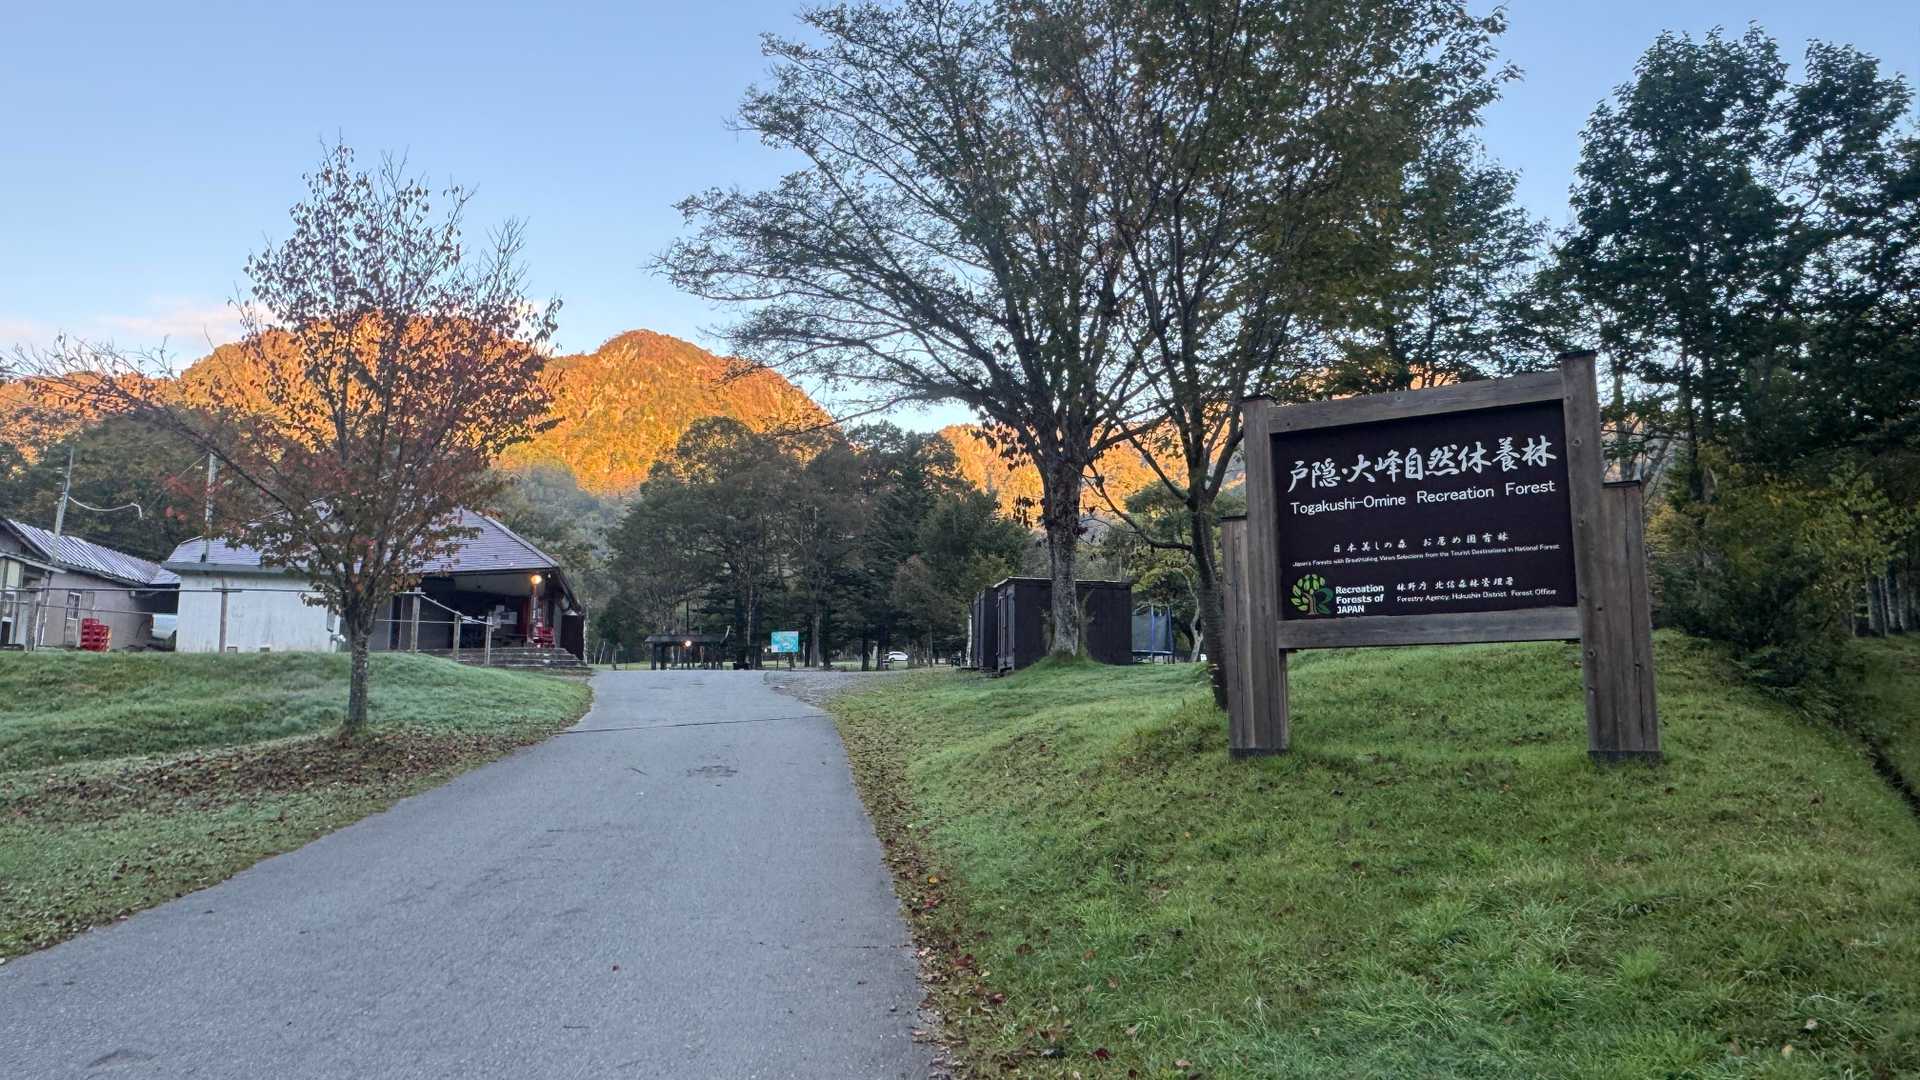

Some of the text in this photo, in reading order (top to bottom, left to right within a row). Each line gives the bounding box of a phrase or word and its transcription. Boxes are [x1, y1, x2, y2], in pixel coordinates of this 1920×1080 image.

[1290, 480, 1556, 516] Togakushi-Omine Recreation Forest
[1335, 585, 1384, 594] Recreation
[1510, 589, 1533, 597] Forest
[1336, 593, 1385, 605] Forests of
[1336, 605, 1365, 615] JAPAN
